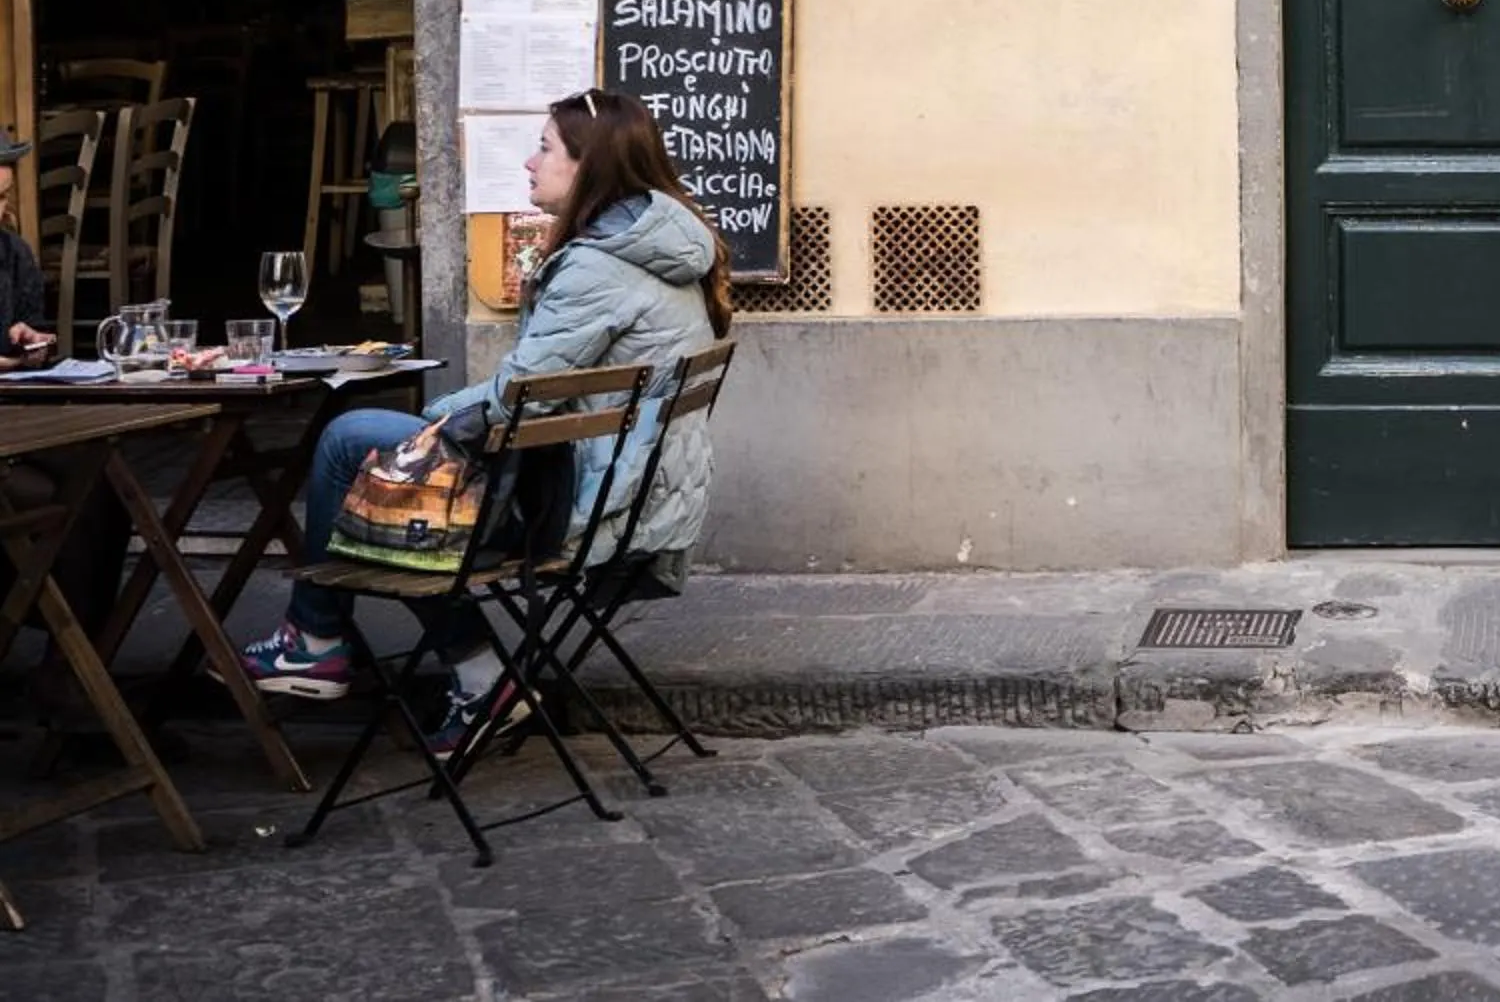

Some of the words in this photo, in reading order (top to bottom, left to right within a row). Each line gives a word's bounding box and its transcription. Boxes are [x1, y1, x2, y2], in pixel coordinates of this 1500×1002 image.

[684, 74, 697, 92] e
[663, 123, 776, 164] ETARIANA
[678, 165, 763, 198] SICCIA
